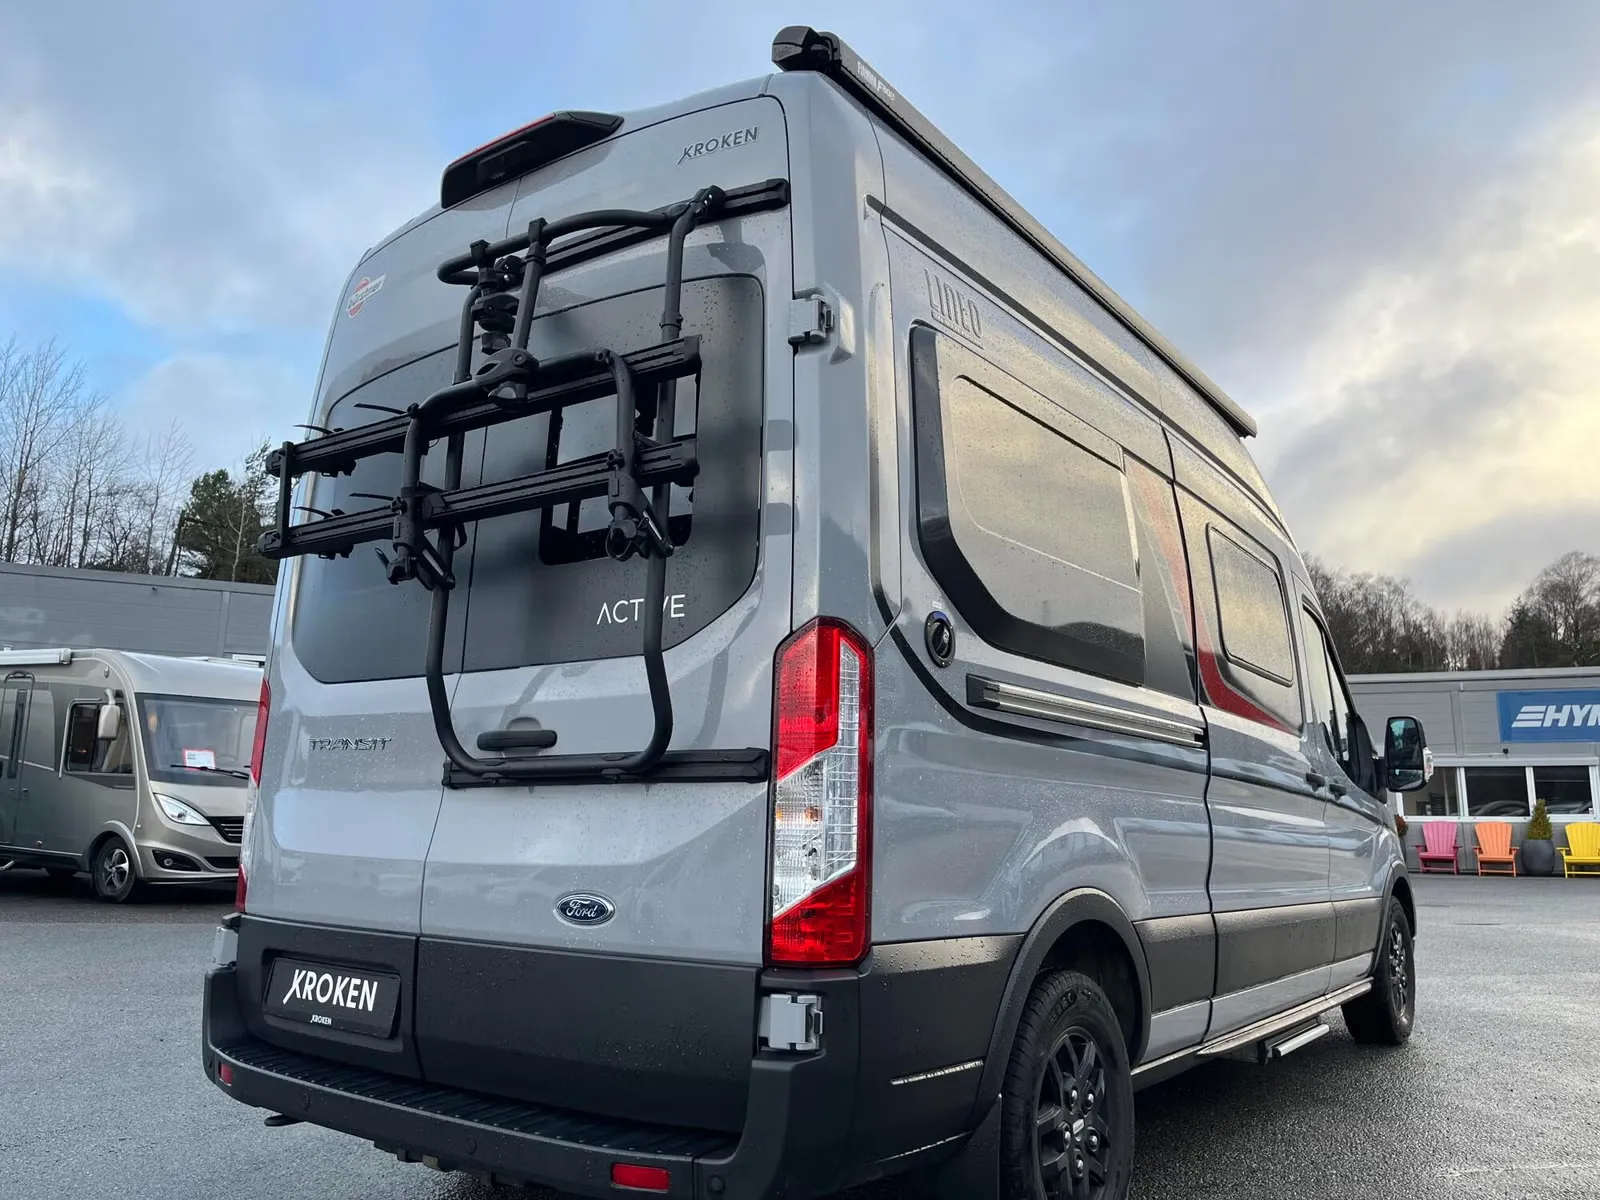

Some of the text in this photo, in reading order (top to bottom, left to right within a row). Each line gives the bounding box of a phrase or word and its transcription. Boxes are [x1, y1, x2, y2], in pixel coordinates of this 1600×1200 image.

[677, 126, 758, 165] KROKEN
[596, 594, 685, 625] ACTE
[308, 738, 392, 751] TRANSIT
[566, 899, 597, 917] Ford
[282, 968, 378, 1012] KROKEN
[309, 1014, 332, 1025] KROKEN
